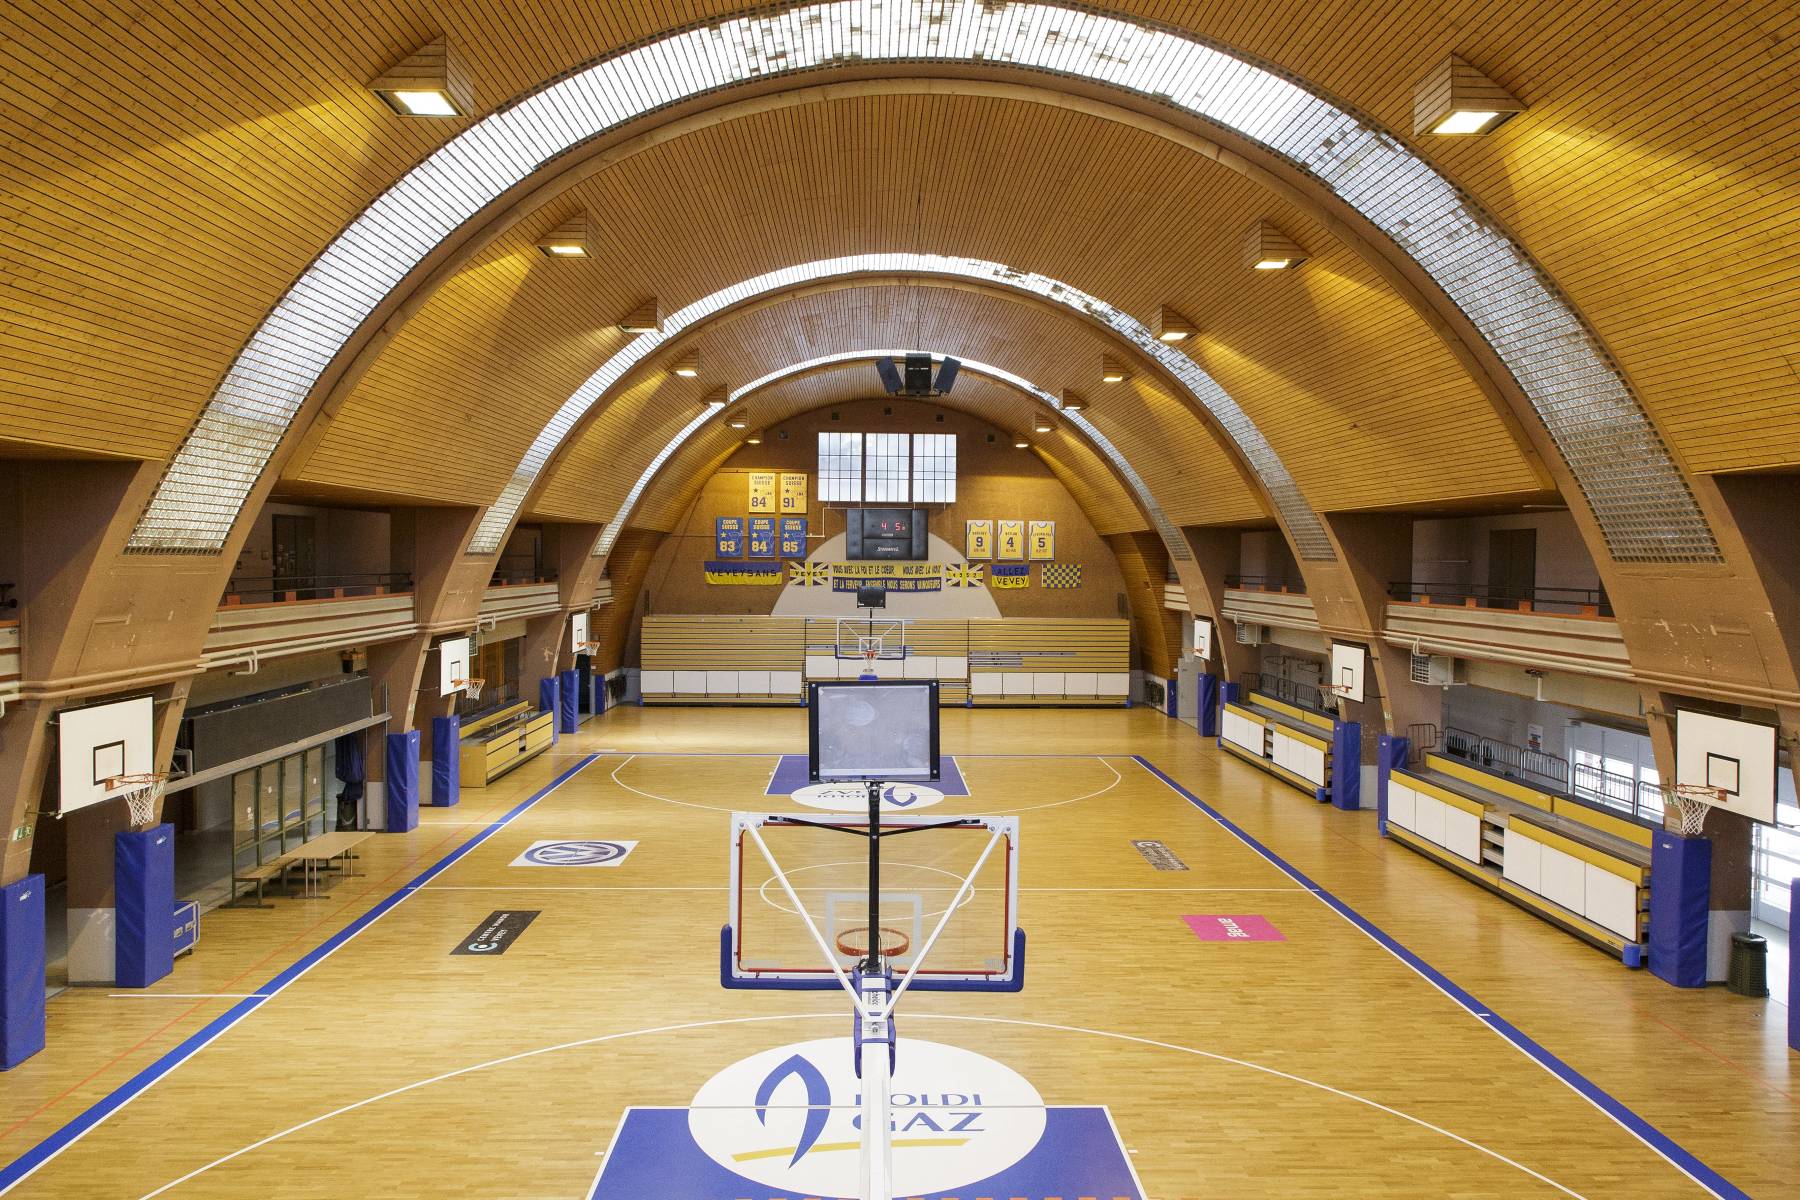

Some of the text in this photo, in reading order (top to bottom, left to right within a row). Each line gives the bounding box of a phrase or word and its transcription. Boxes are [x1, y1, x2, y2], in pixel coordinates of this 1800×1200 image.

[751, 496, 766, 507] 84
[783, 497, 795, 508] 91
[720, 541, 736, 552] 83
[751, 541, 768, 552] 84
[783, 541, 798, 552] 85
[976, 536, 983, 547] 9
[1006, 537, 1014, 547] 4
[1038, 537, 1045, 548] 5
[854, 565, 860, 575] LA
[868, 565, 874, 575] ET
[874, 565, 880, 575] LE
[996, 577, 1026, 586] VEVEY
[1217, 918, 1251, 938] amag
[477, 926, 496, 942] CENTRE
[490, 929, 508, 942] VEVEY
